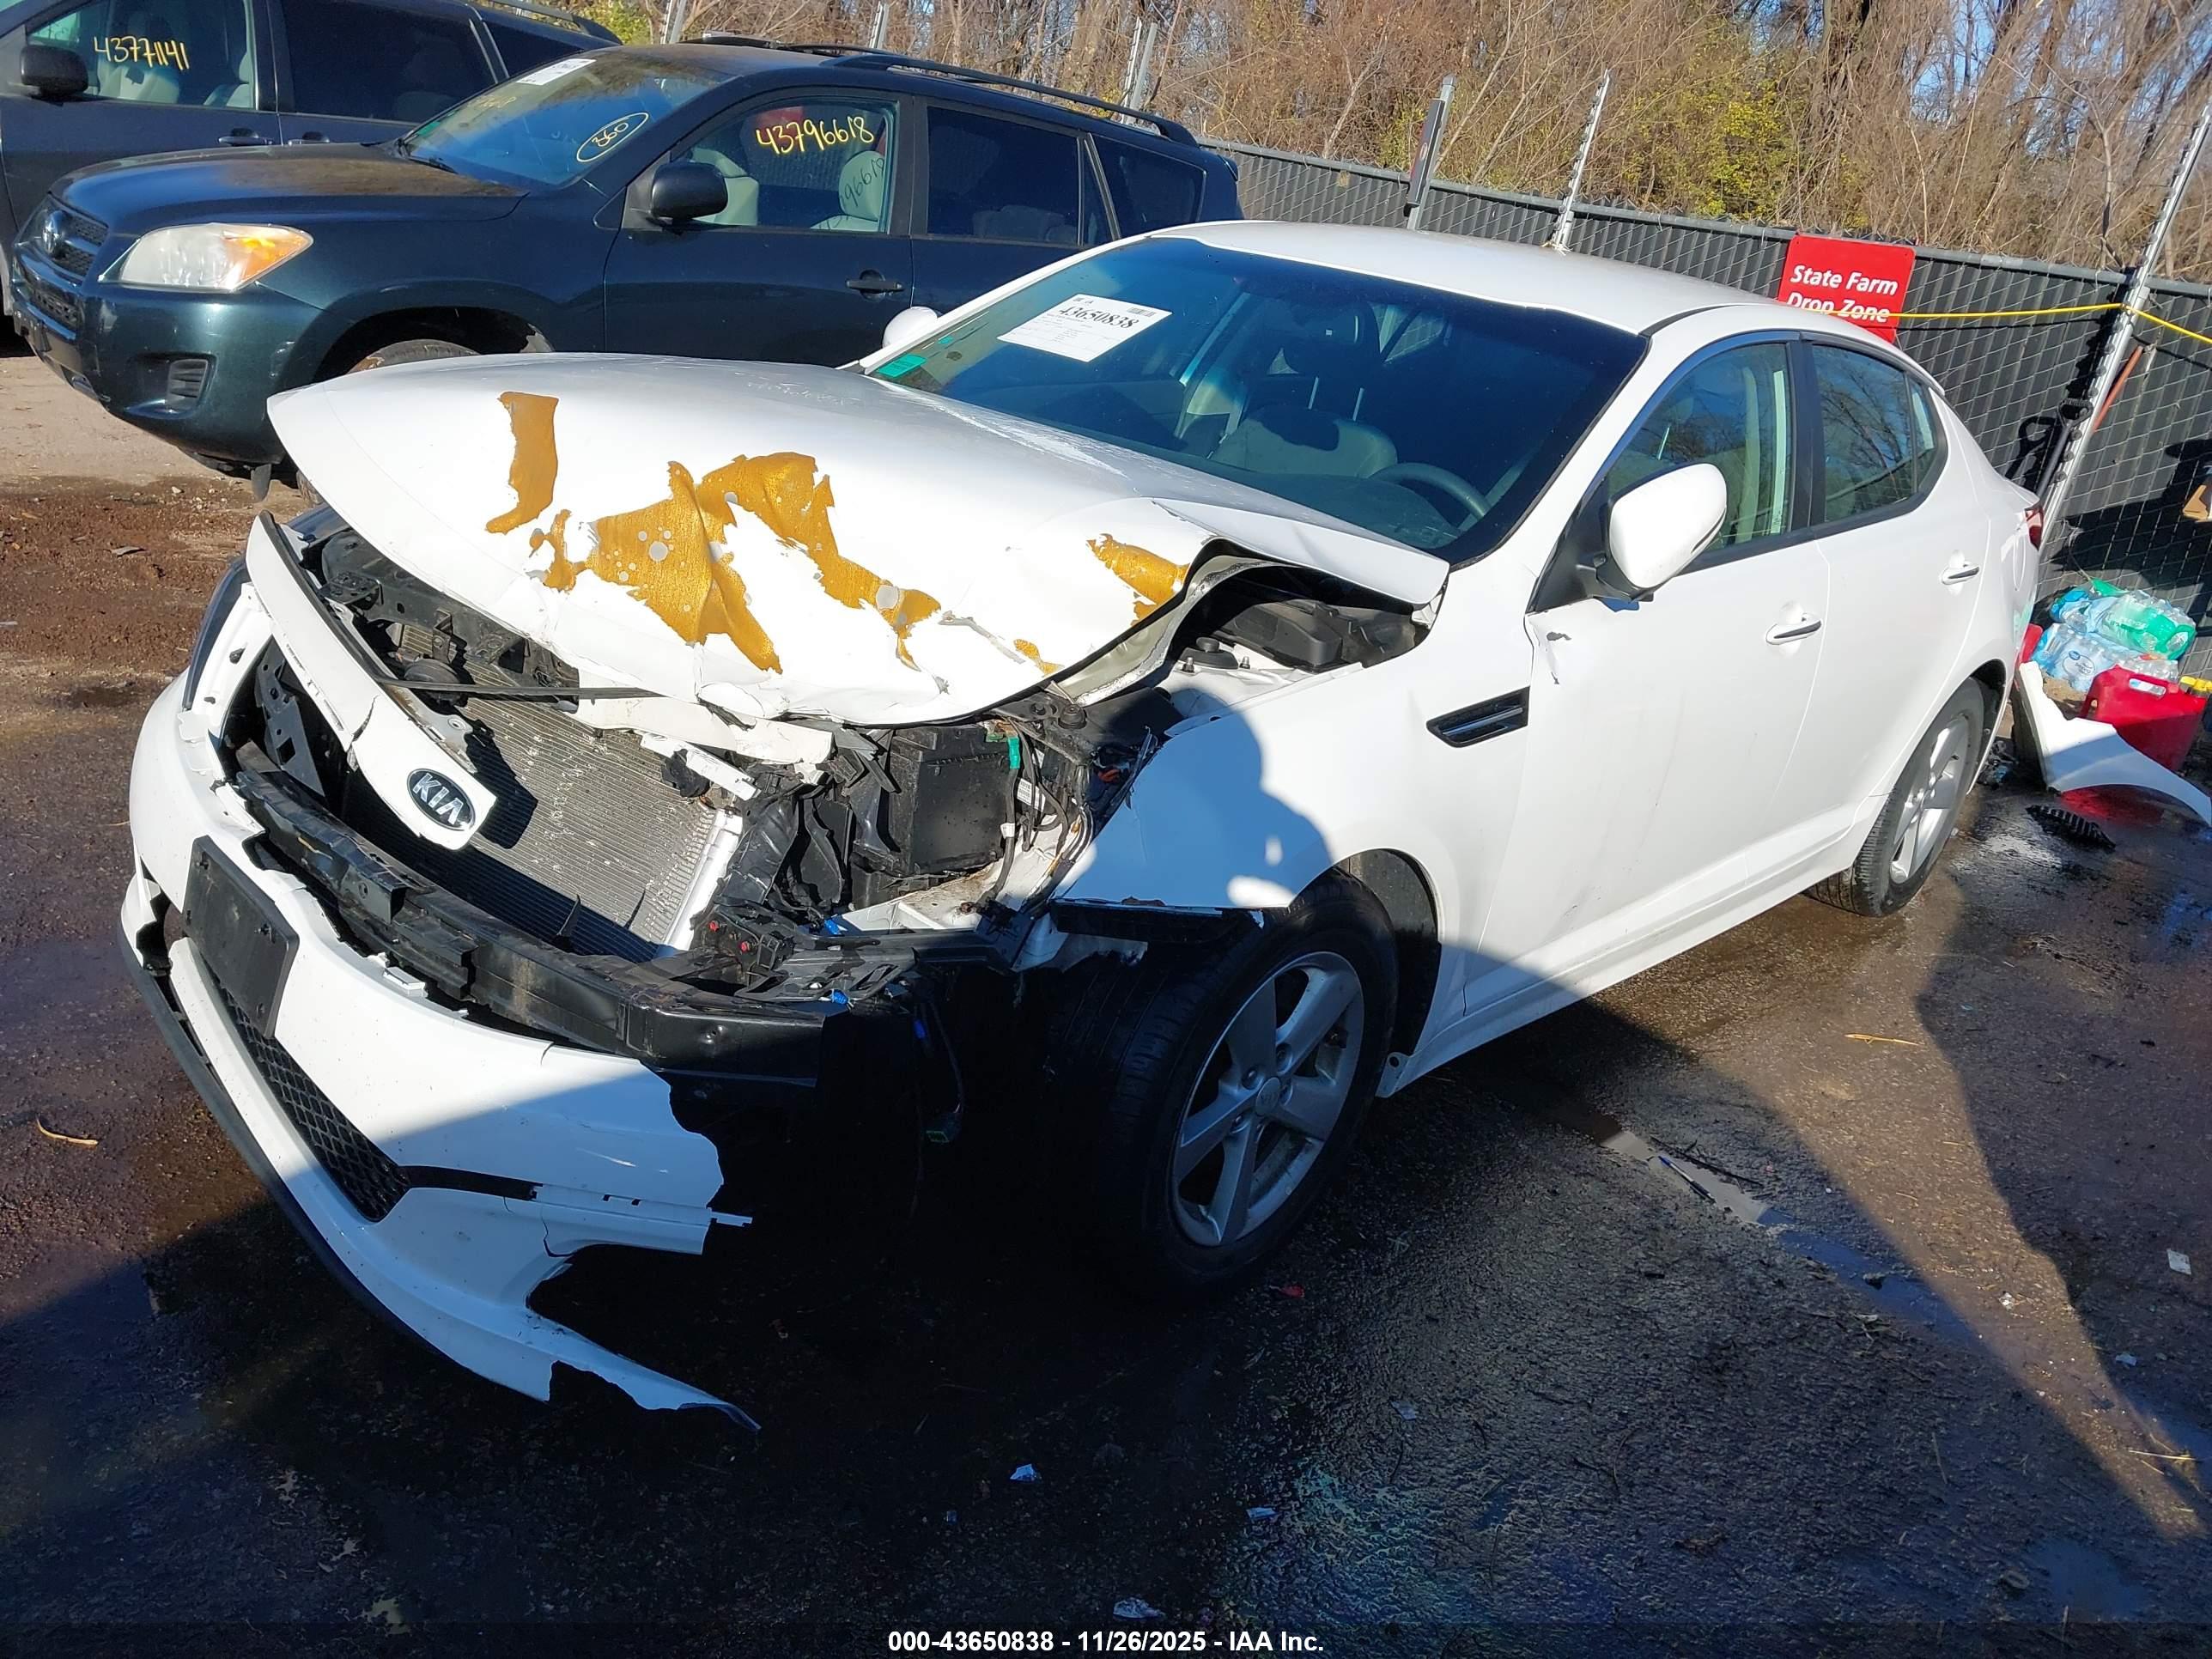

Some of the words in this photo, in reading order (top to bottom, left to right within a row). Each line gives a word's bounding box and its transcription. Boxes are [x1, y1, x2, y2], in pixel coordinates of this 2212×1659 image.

[93, 35, 190, 70] 43771141
[755, 115, 875, 155] 43796618
[1790, 264, 1843, 289] State
[1846, 271, 1899, 296] Farm
[1059, 305, 1140, 330] 43650838
[1786, 293, 1835, 315] Drop
[1838, 299, 1891, 323] Zone
[412, 772, 464, 825] KIA
